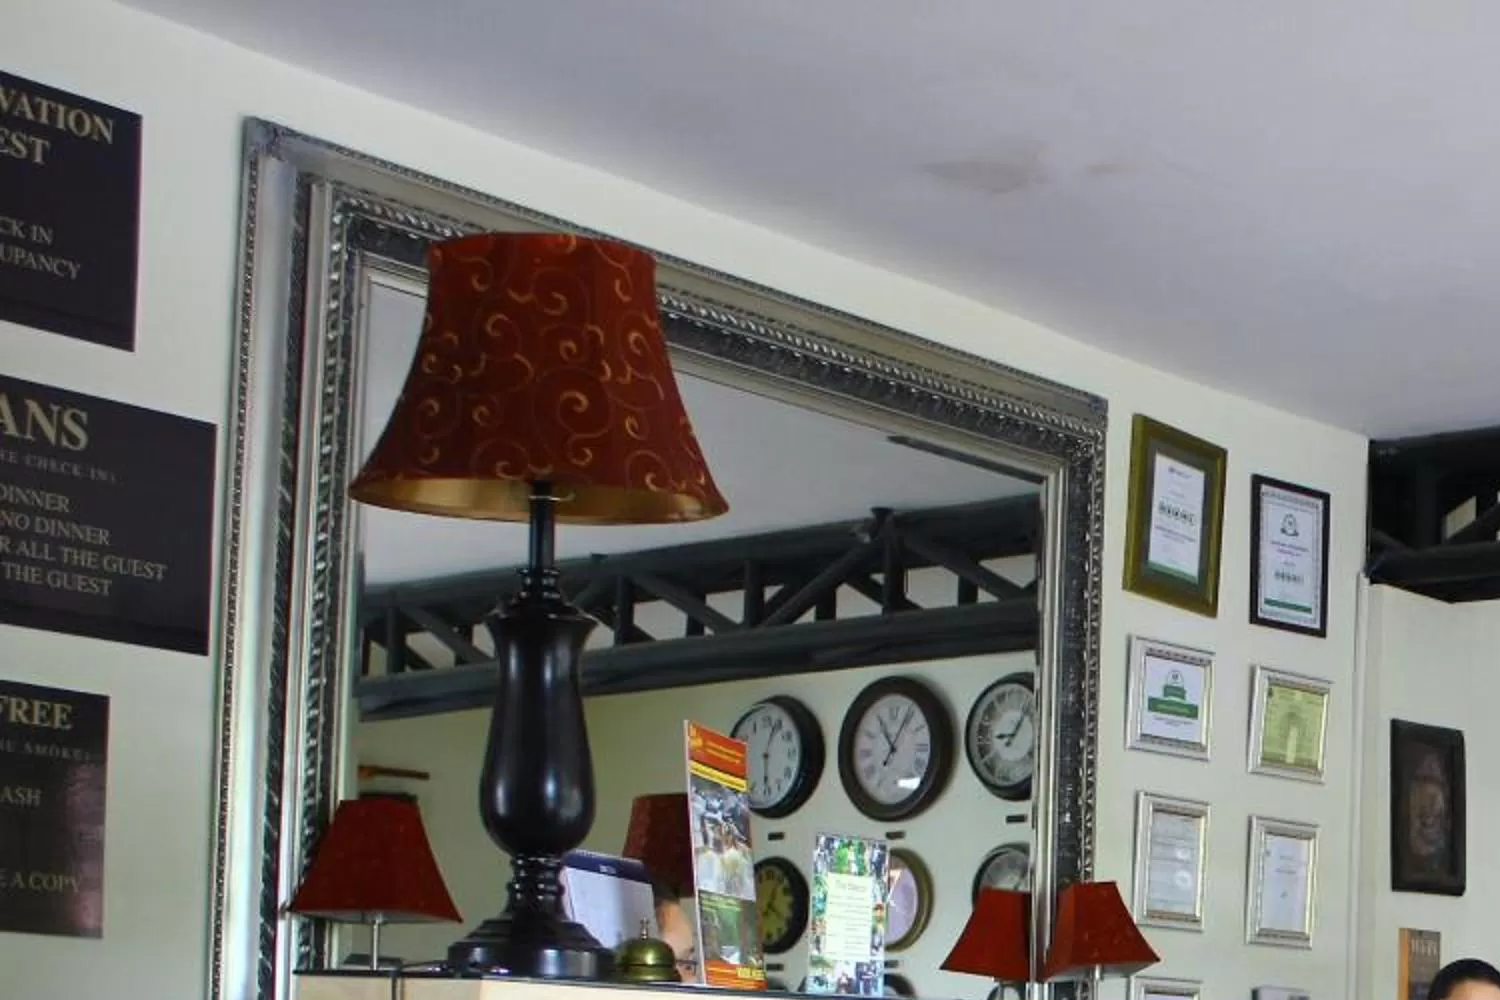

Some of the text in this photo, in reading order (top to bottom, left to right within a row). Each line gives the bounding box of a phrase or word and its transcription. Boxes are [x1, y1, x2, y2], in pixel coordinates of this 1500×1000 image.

[34, 515, 112, 546] DINNER
[16, 539, 56, 562] ALL
[59, 545, 100, 569] THE
[103, 553, 168, 584] GUEST
[47, 568, 113, 597] GUEST
